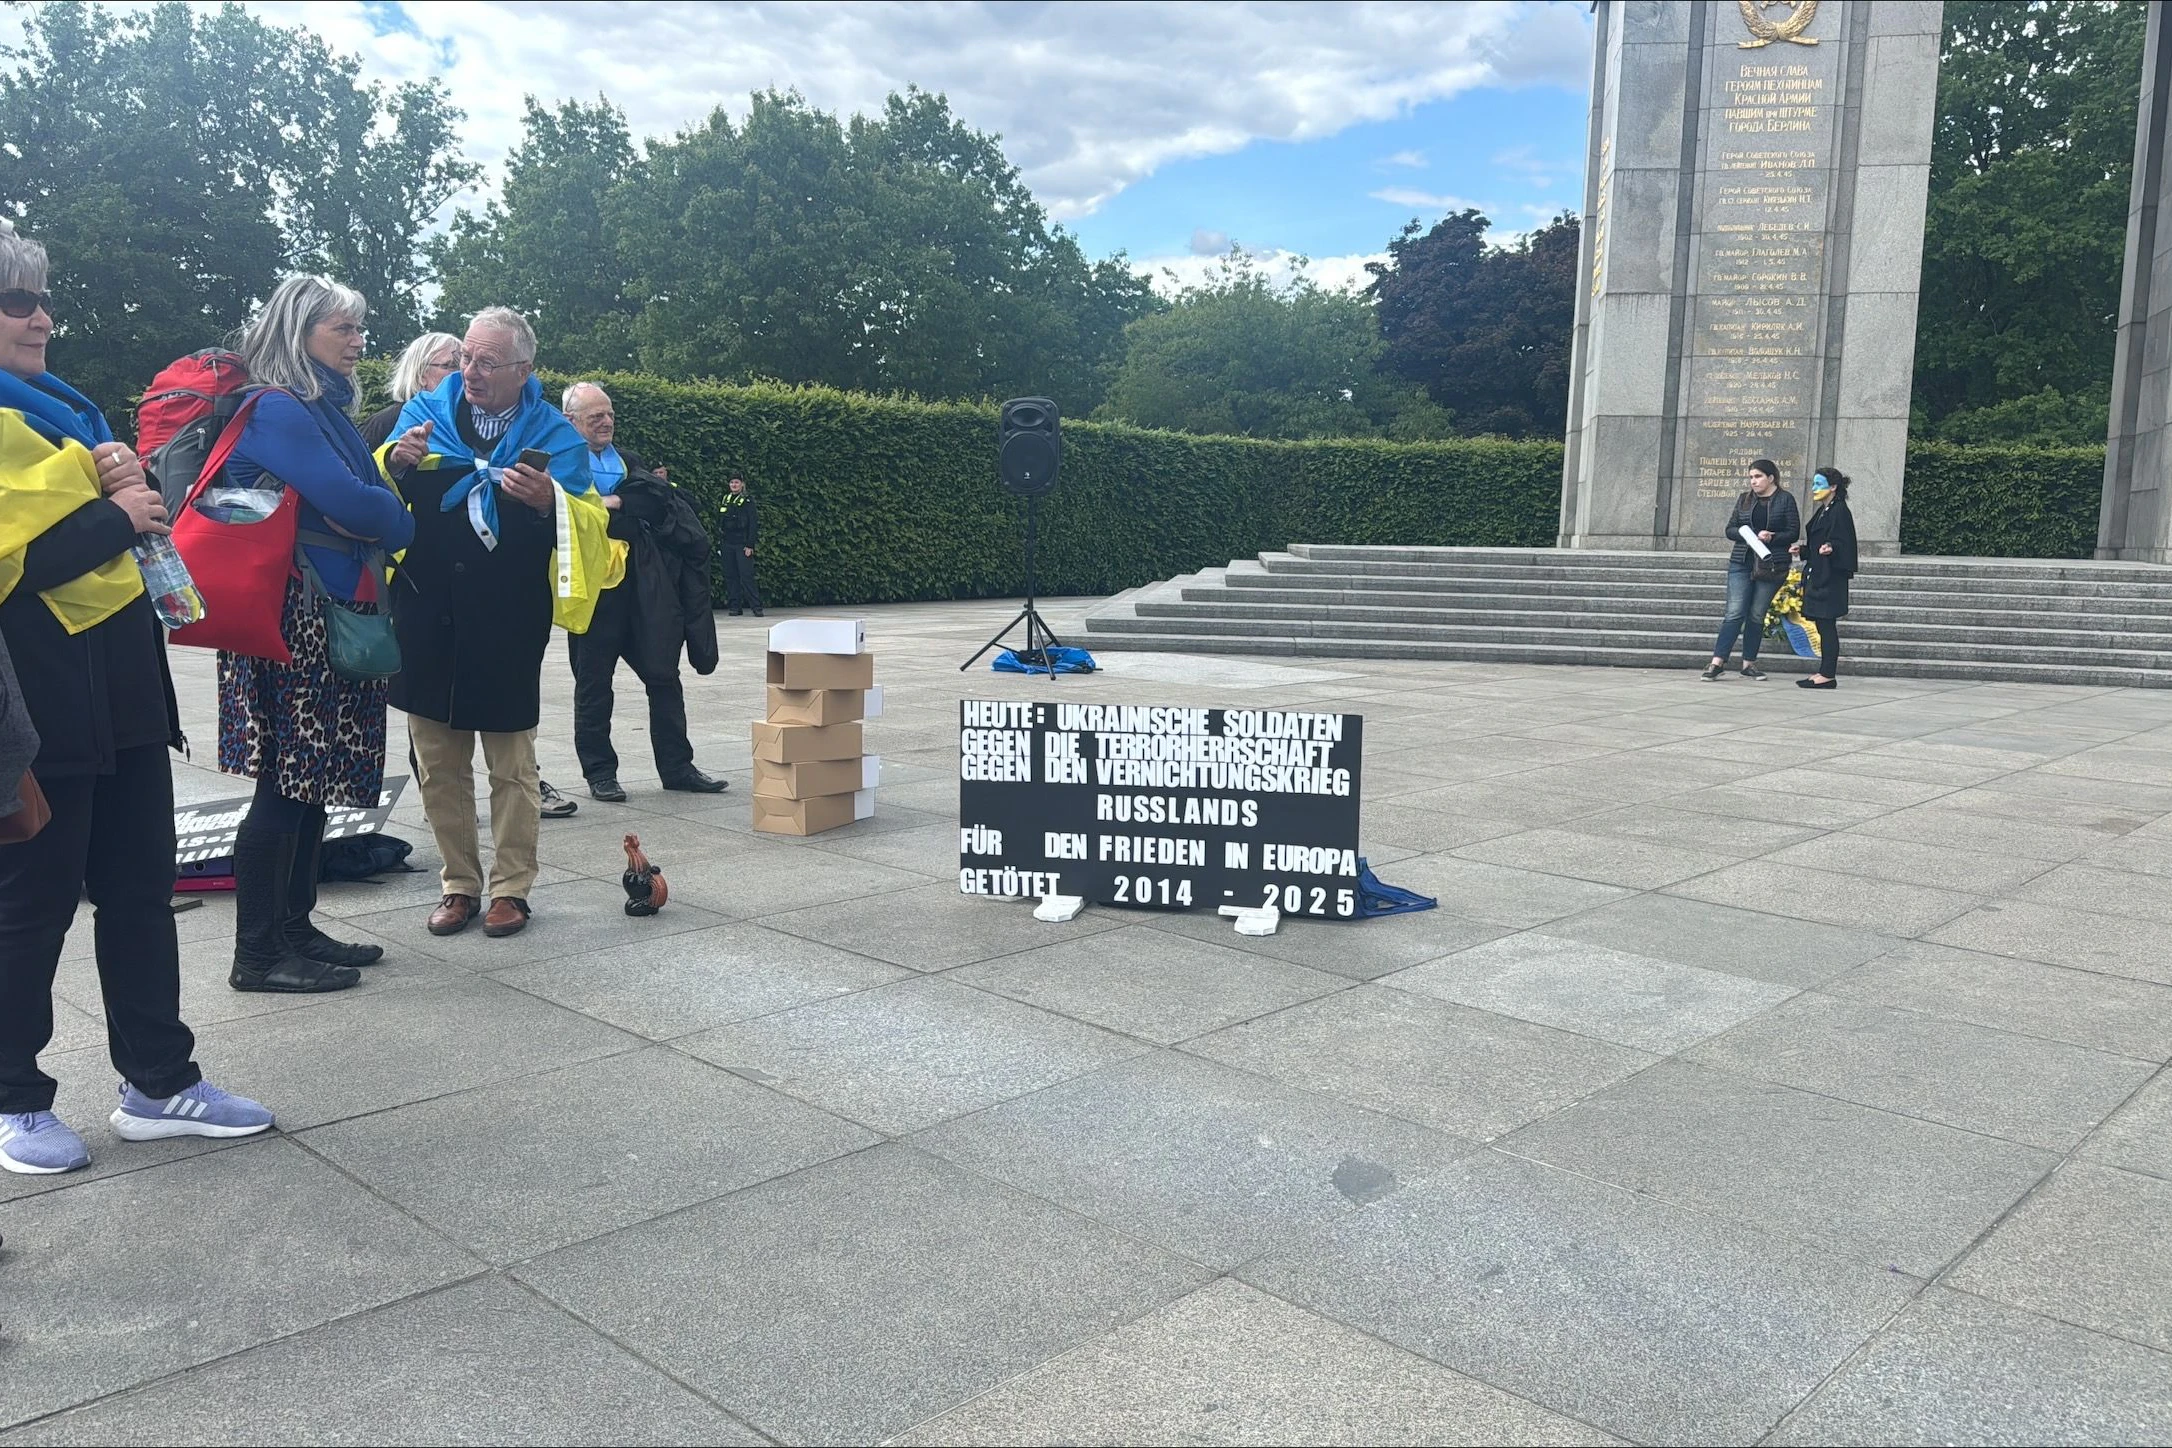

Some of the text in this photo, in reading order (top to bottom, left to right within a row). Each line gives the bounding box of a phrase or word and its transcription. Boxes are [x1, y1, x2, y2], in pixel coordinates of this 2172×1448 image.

[964, 701, 1342, 741] HEUTE: UKRAINISCHE SOLDATEN
[962, 729, 1333, 767] GEGEN DIE TERRORHERRSCHAFT
[962, 755, 1350, 796] GEGEN DEN VERNICHTUNGSKRIEG
[1098, 795, 1258, 827] RUSSLANDS
[960, 825, 1357, 877] FÜR DEN FRIEDEN IN EUROPA
[960, 866, 1061, 896] GETÖTET
[1114, 876, 1192, 905] 2014
[1263, 883, 1354, 916] 2025
